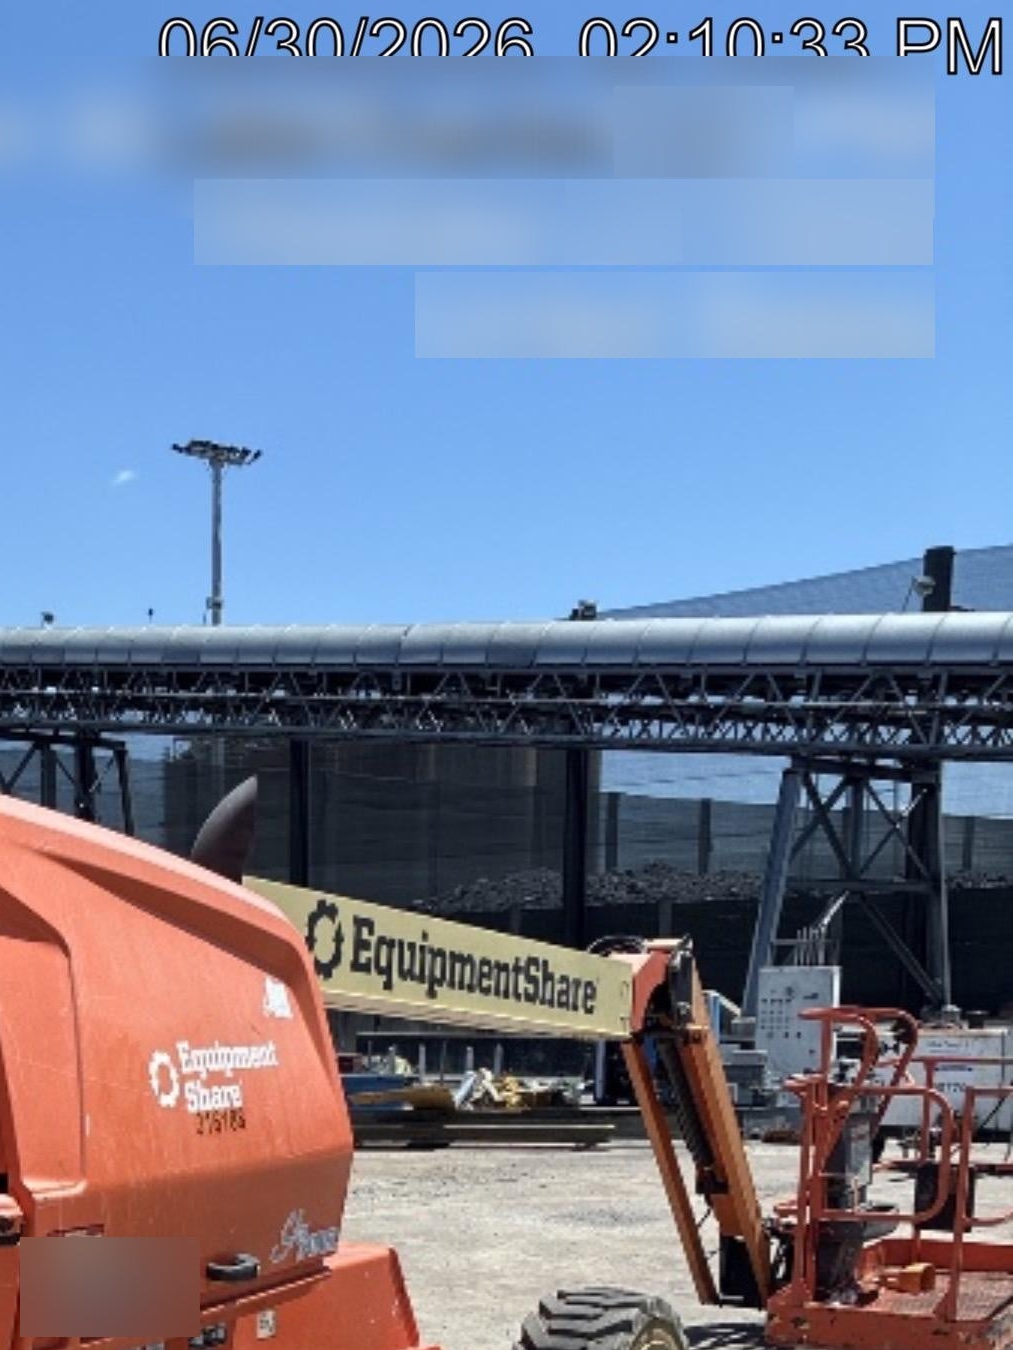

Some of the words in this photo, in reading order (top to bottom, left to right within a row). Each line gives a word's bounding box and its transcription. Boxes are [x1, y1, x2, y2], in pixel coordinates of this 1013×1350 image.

[350, 914, 598, 1014] EquipmentShare
[176, 1039, 278, 1080] Equipment
[184, 1079, 244, 1114] Share
